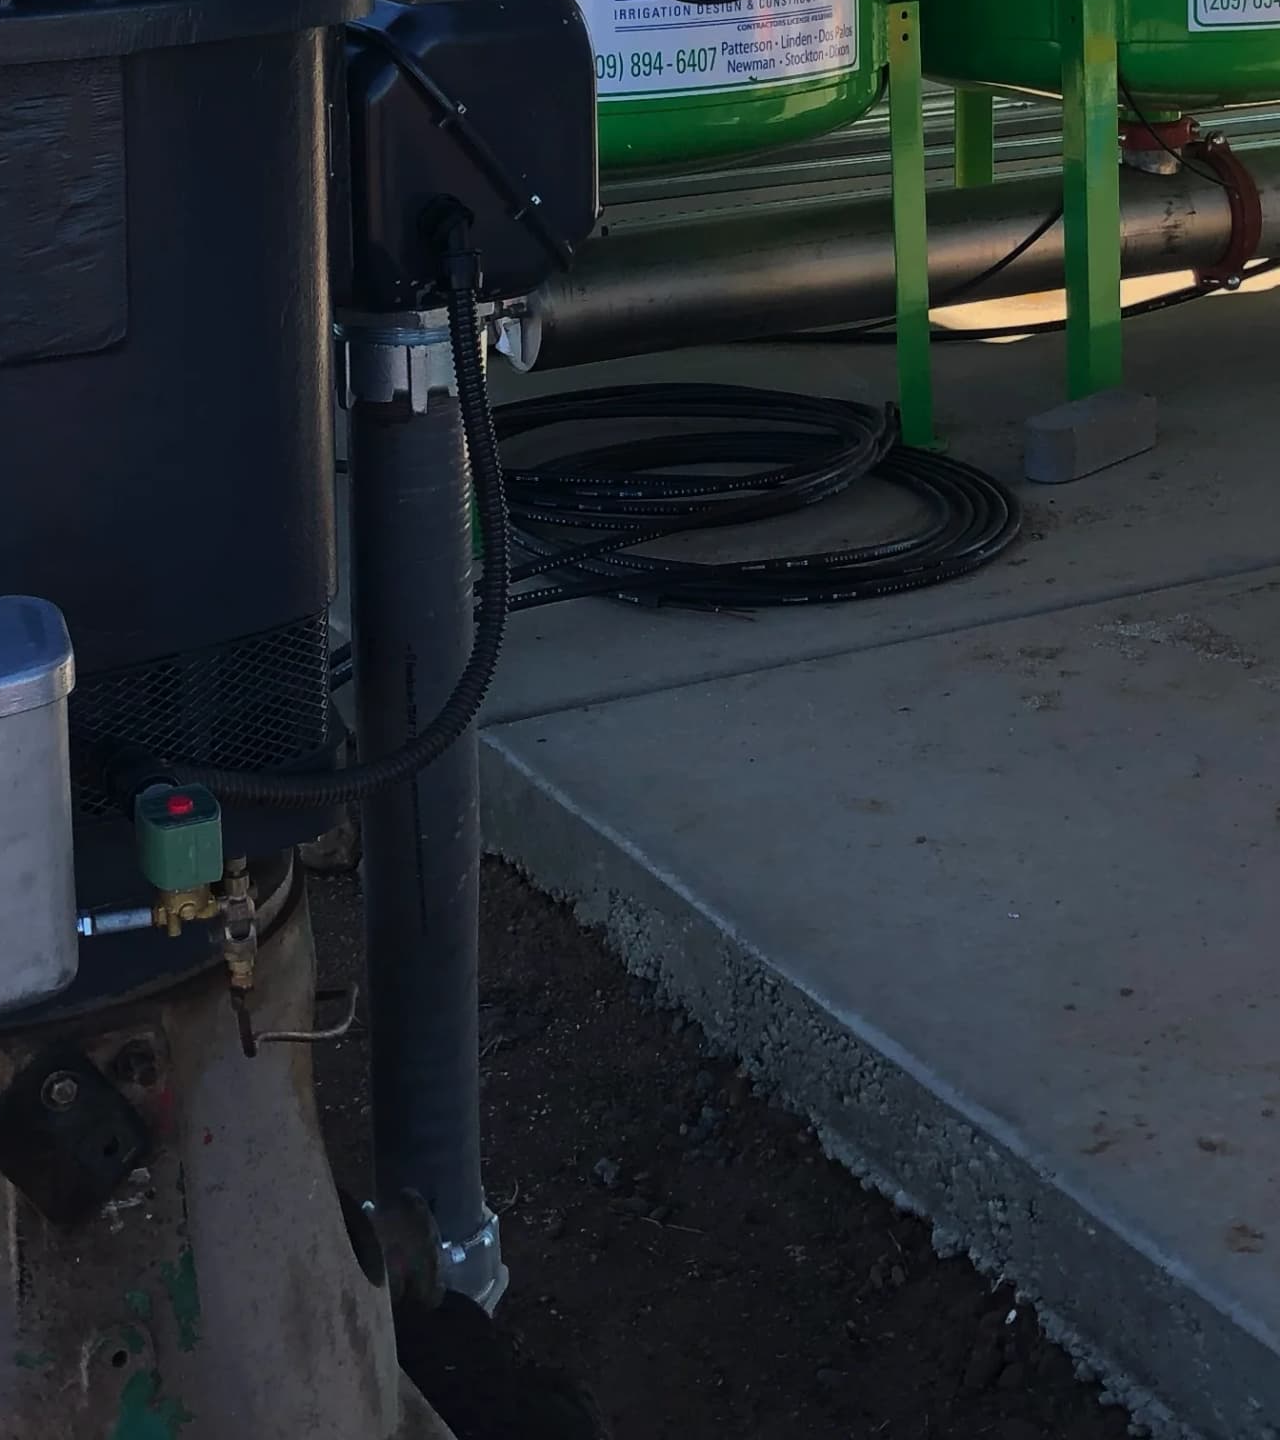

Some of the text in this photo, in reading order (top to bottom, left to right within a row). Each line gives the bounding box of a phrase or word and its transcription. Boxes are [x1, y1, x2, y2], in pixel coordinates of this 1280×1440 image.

[614, 4, 692, 21] IRRIGATION
[697, 0, 742, 15] DESIGN
[747, 0, 754, 10] &
[721, 23, 853, 56] Patterson Linden Dos Palos
[737, 20, 786, 32] CONTRACTORS
[631, 46, 718, 77] 894-6407
[727, 44, 850, 73] Newman Stockton Dixon
